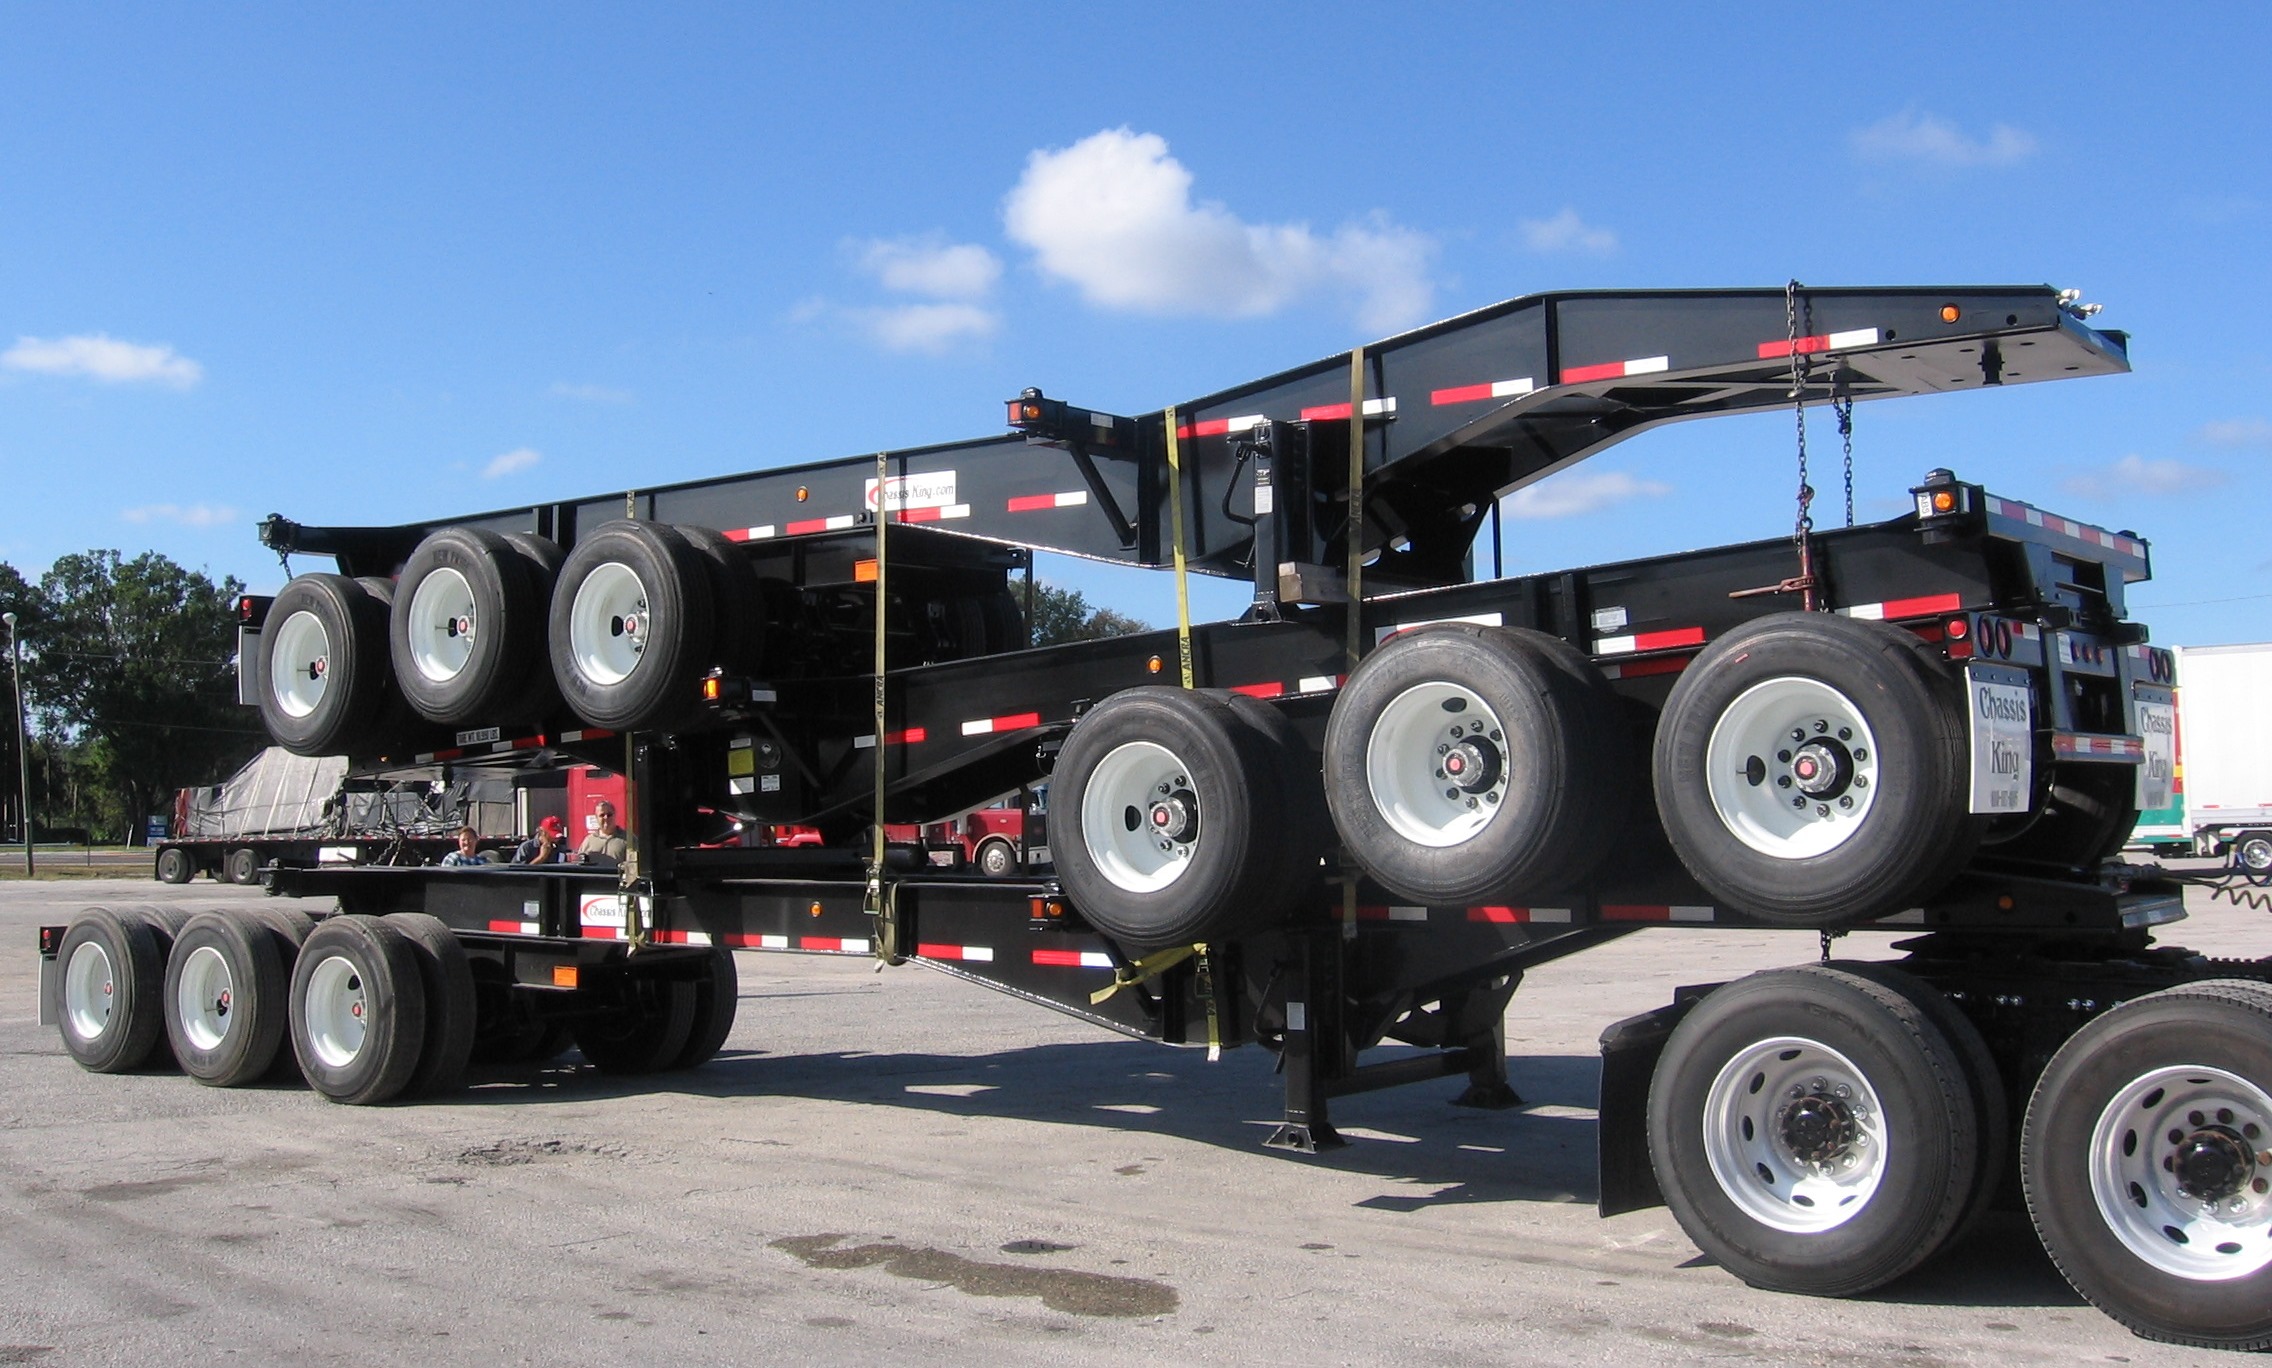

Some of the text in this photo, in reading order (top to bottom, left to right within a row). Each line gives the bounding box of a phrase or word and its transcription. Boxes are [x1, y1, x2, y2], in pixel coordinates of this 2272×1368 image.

[1180, 636, 1191, 671] ANCRA
[1979, 686, 2027, 722] Chassis
[2140, 706, 2172, 736] Chassis
[1991, 740, 2019, 781] King
[2148, 750, 2167, 784] King
